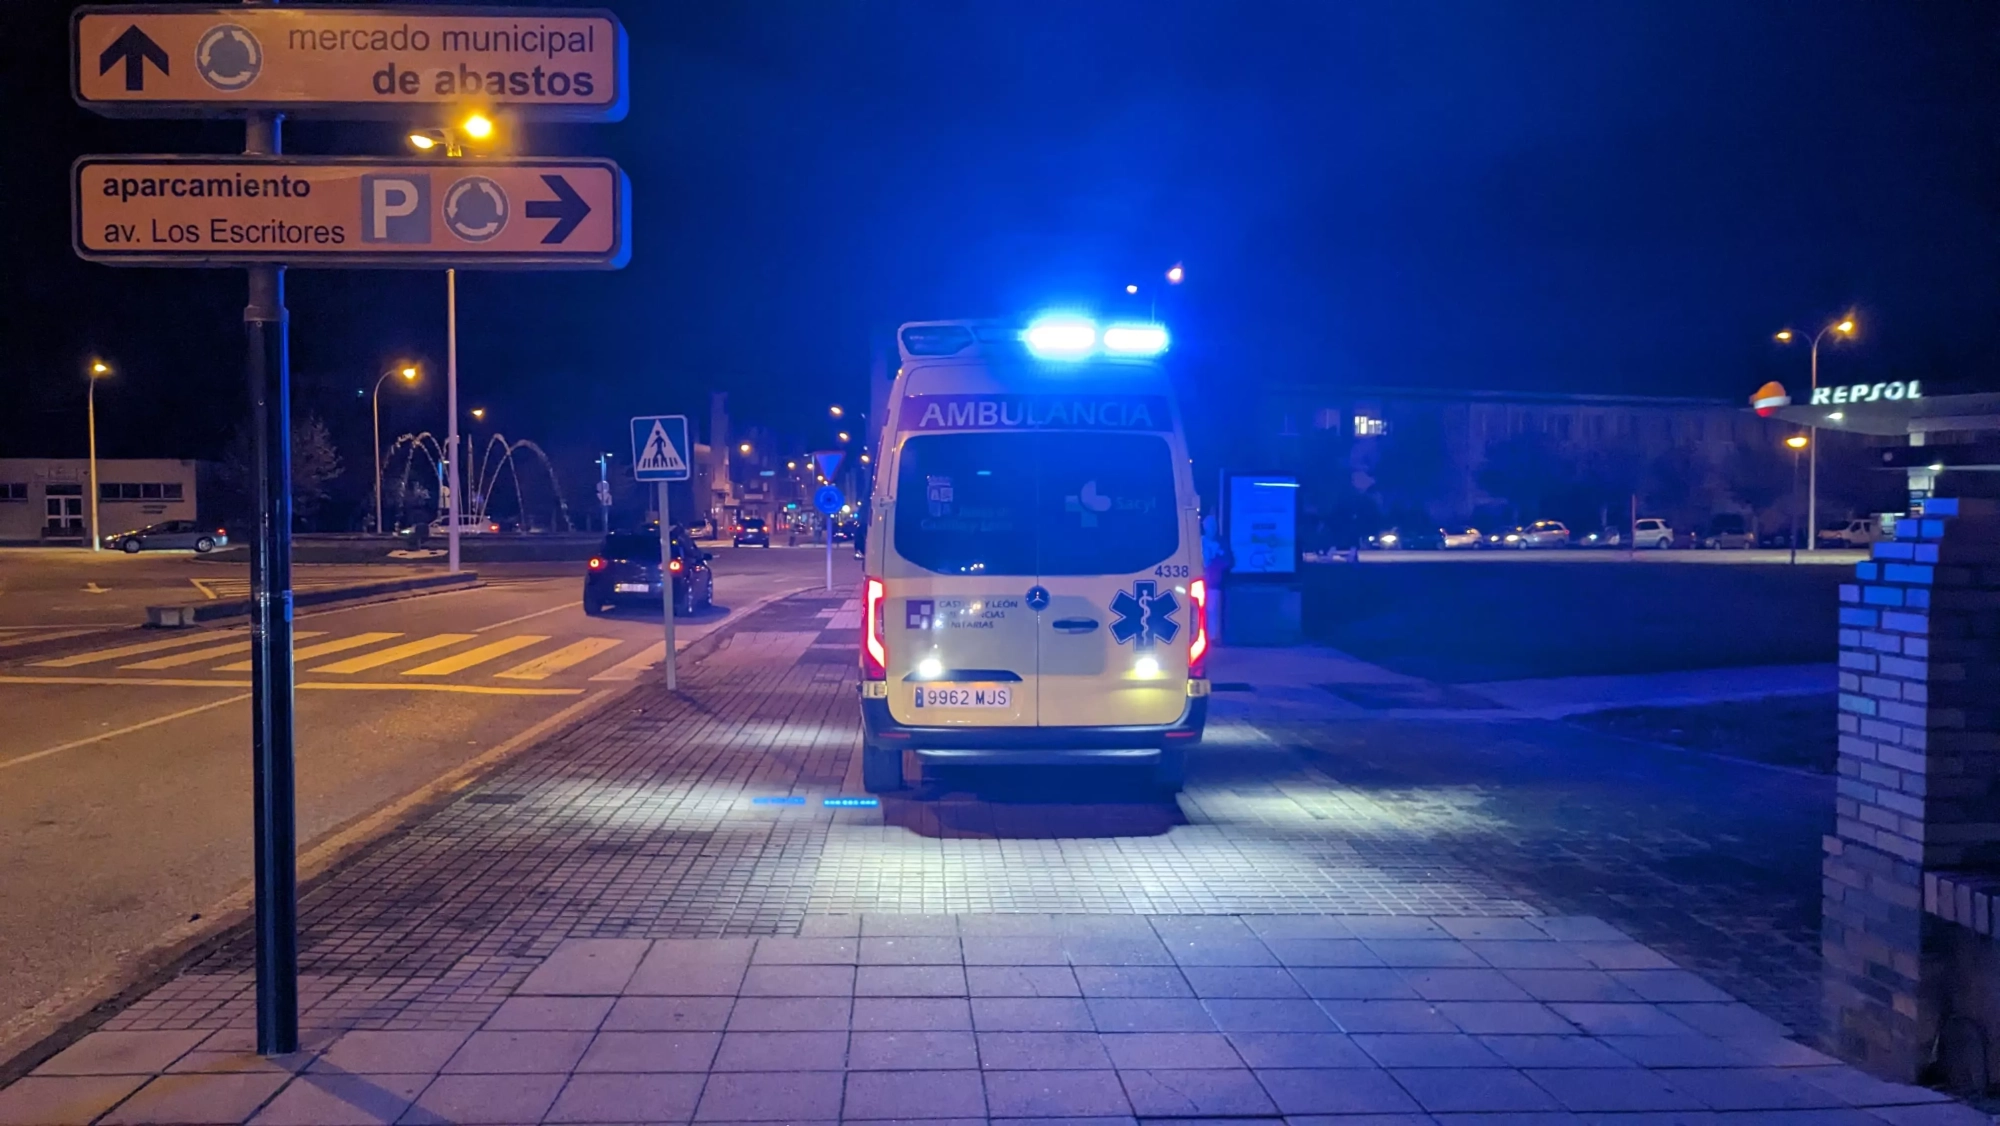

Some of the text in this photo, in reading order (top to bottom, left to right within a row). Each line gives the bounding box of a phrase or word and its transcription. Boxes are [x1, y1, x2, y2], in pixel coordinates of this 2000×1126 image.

[289, 24, 594, 59] mercado municipal
[372, 63, 594, 96] de abastos
[103, 173, 310, 202] aparcamiento
[373, 179, 418, 238] P
[104, 219, 345, 244] av. Los Escritores
[1810, 380, 1922, 405] REPSOL
[918, 401, 1153, 427] AMBULANCIA
[1115, 495, 1157, 513] Sacyl
[1154, 565, 1189, 578] 4338
[928, 690, 1007, 705] 9962 MJS
